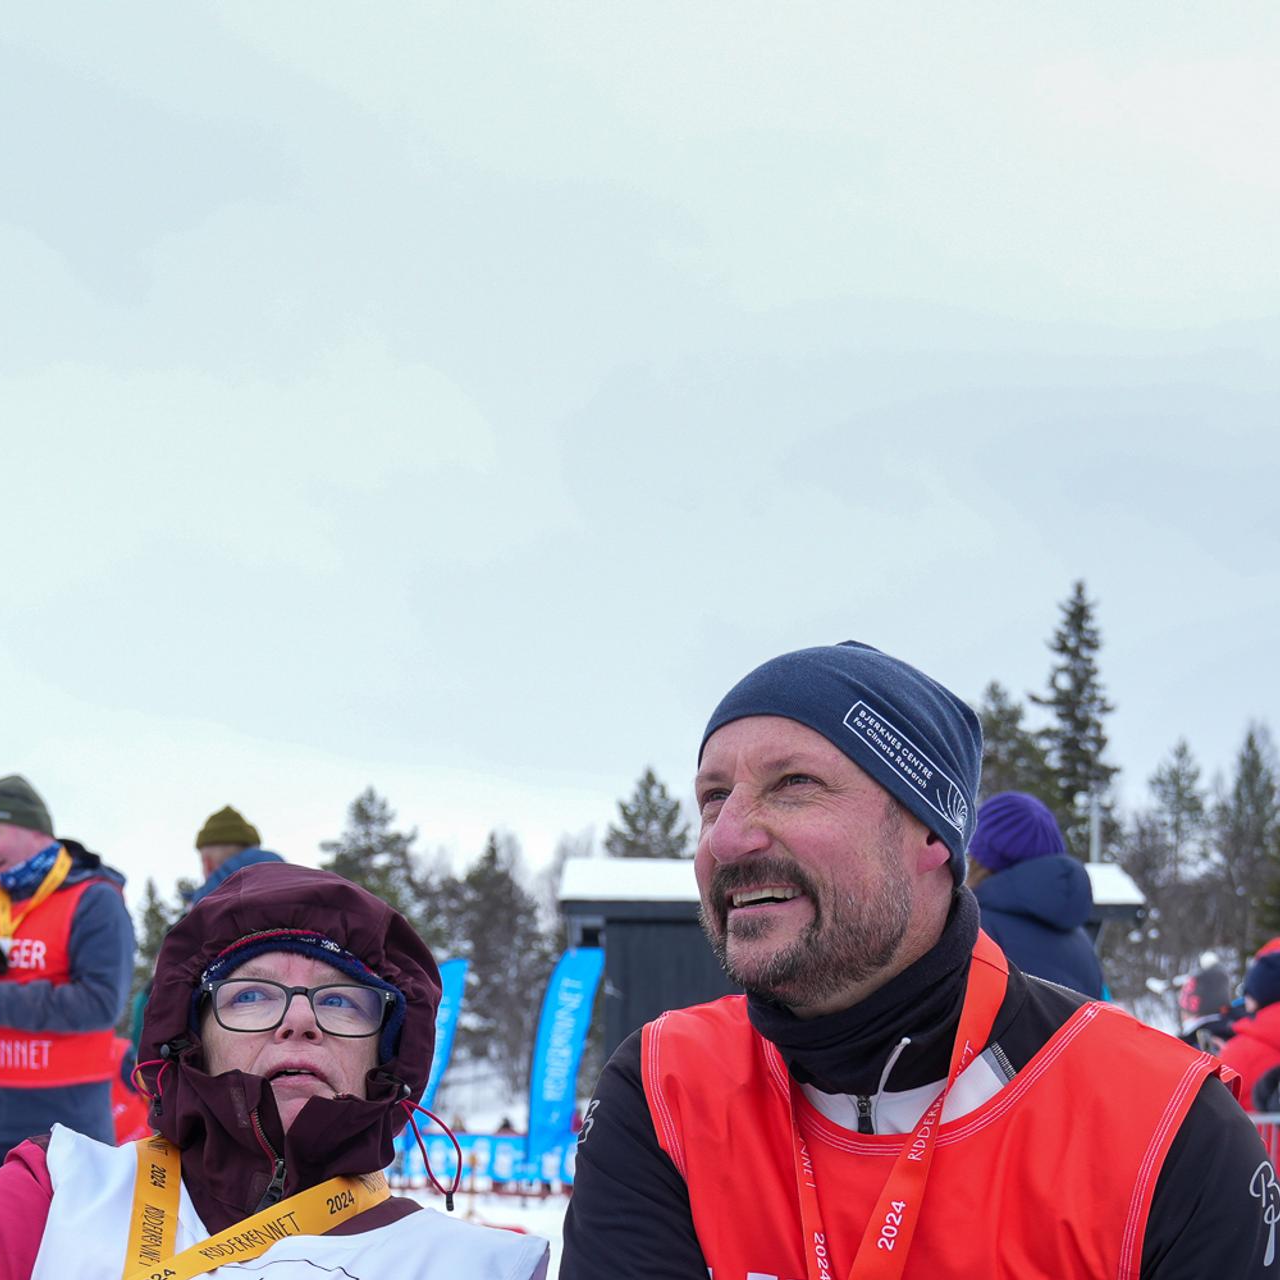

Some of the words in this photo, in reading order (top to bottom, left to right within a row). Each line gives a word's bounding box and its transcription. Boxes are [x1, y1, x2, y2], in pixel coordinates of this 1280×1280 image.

[853, 717, 867, 729] for
[866, 728, 895, 758] Climate
[895, 756, 927, 789] Research
[859, 709, 902, 751] BJERKNES
[902, 748, 934, 779] CENTRE
[131, 1164, 166, 1189] 2024
[326, 1190, 355, 1215] 2024
[877, 1200, 906, 1250] 2024
[199, 1211, 301, 1261] RIDDERRENNET
